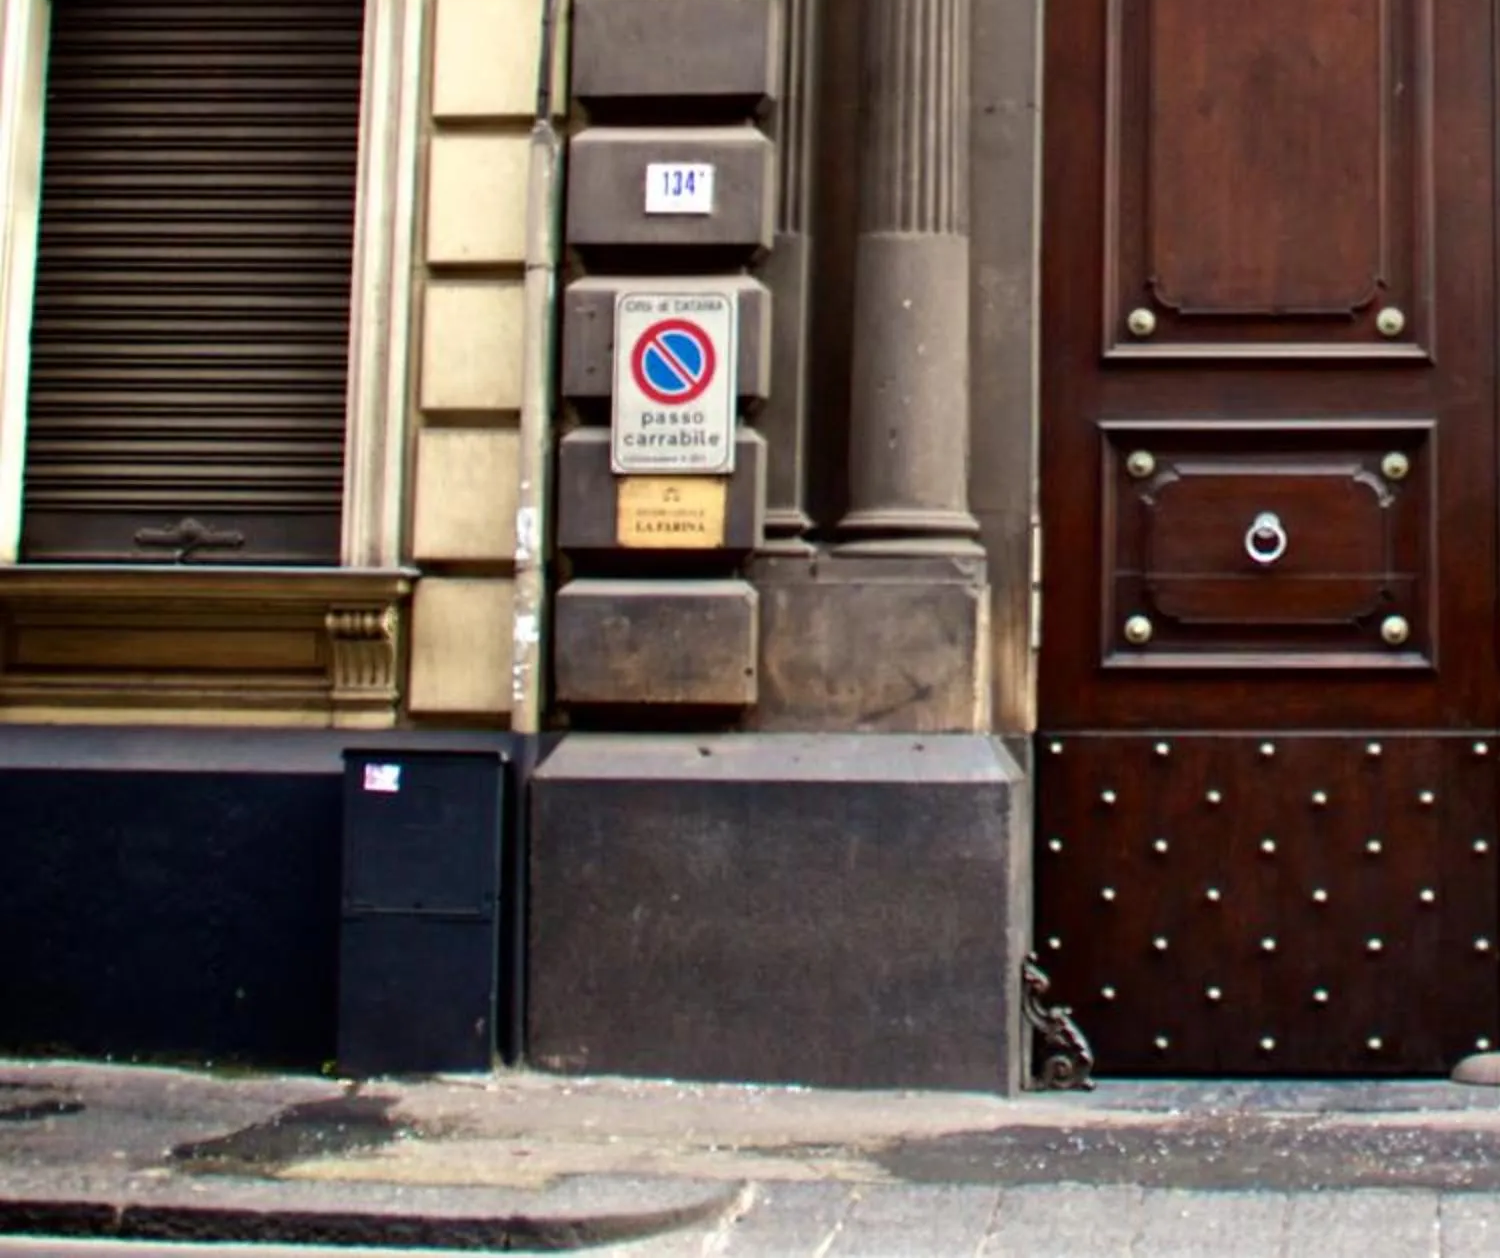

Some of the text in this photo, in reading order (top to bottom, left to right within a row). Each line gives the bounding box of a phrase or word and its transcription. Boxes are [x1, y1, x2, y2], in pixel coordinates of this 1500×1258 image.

[663, 170, 695, 196] 134
[641, 411, 704, 429] passo
[623, 430, 720, 447] carrabile
